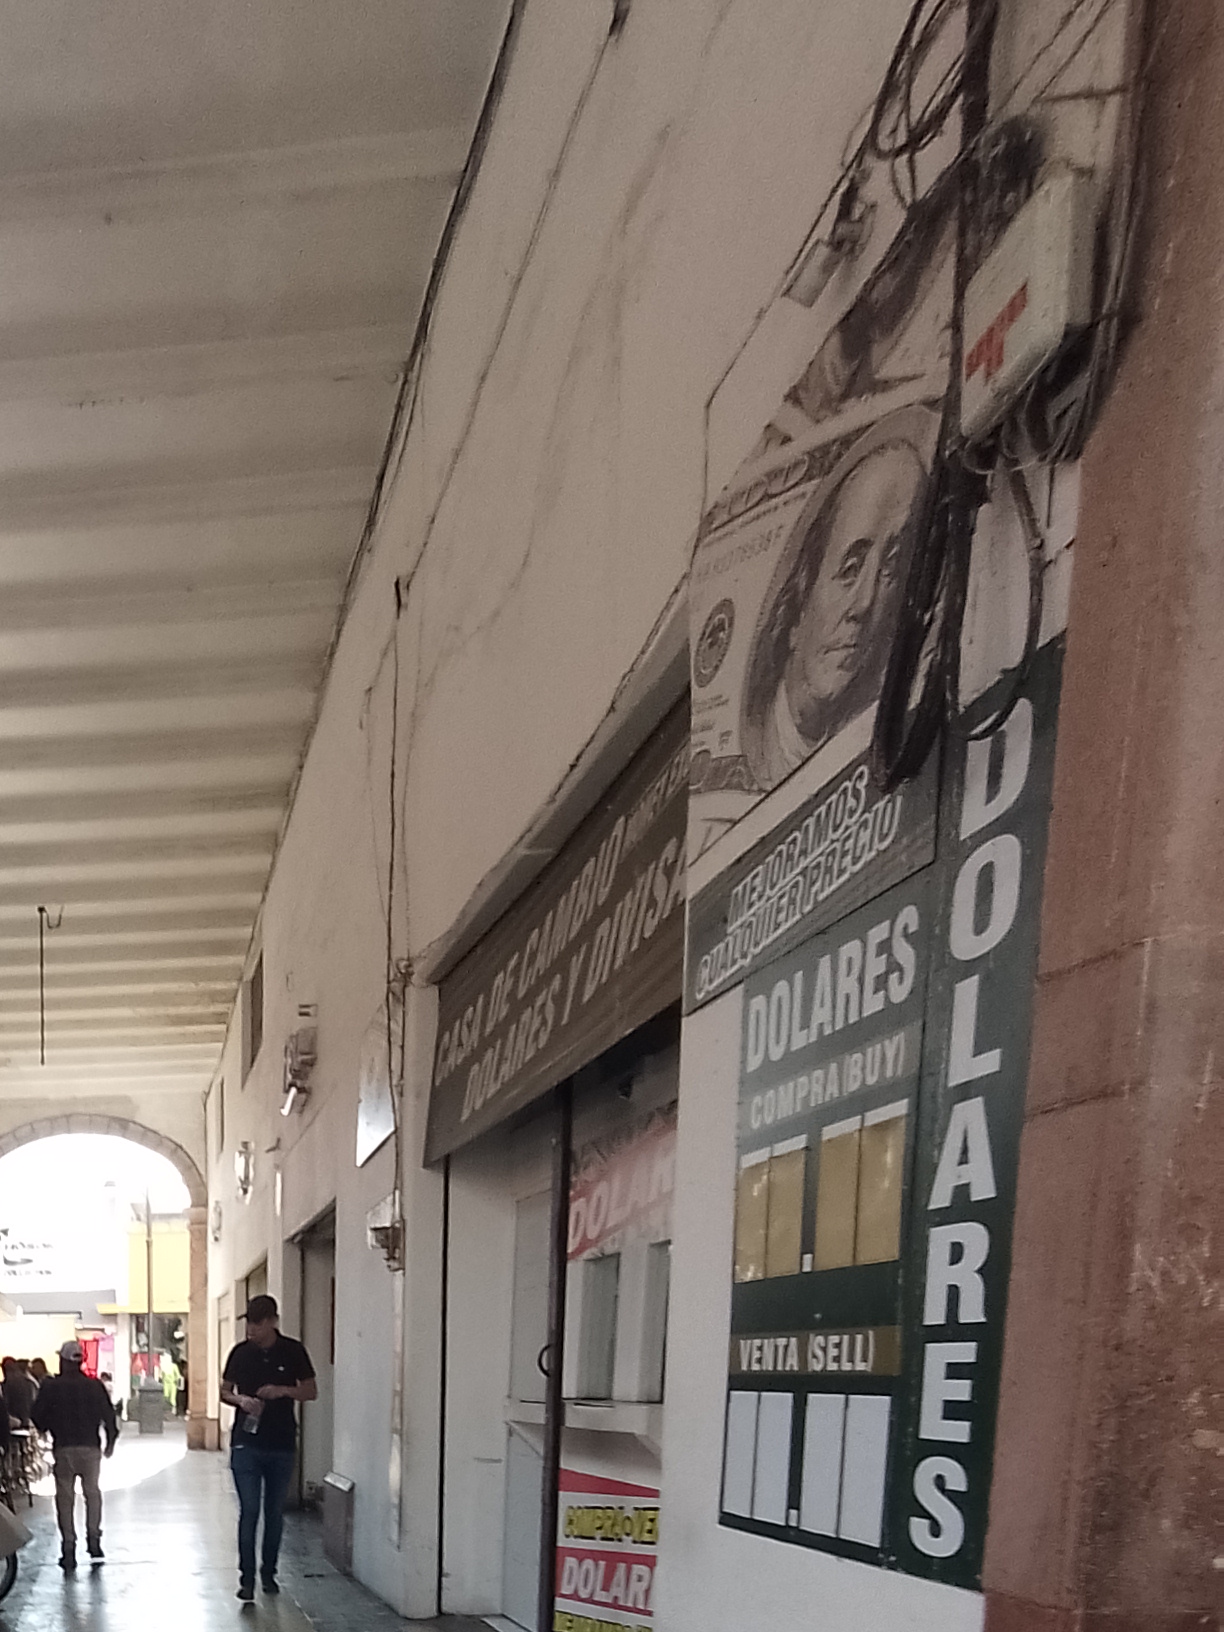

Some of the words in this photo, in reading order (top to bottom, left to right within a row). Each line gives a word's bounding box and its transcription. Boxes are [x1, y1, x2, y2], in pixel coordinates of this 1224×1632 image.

[695, 874, 804, 1001] CUALQUIER
[802, 794, 903, 914] PRECIO
[727, 764, 869, 935] MEJORAMOS
[435, 994, 484, 1087] CASA
[484, 951, 520, 1038] DE
[517, 814, 626, 1001] CAMBIO
[460, 973, 562, 1123] DOLARES
[561, 942, 588, 1027] Y
[745, 904, 920, 1074] DOLARES
[908, 697, 1033, 1558] DOLARES
[739, 1336, 800, 1372] VENTA
[807, 1329, 875, 1373] (SELL)
[559, 1555, 654, 1611] DOLAR
